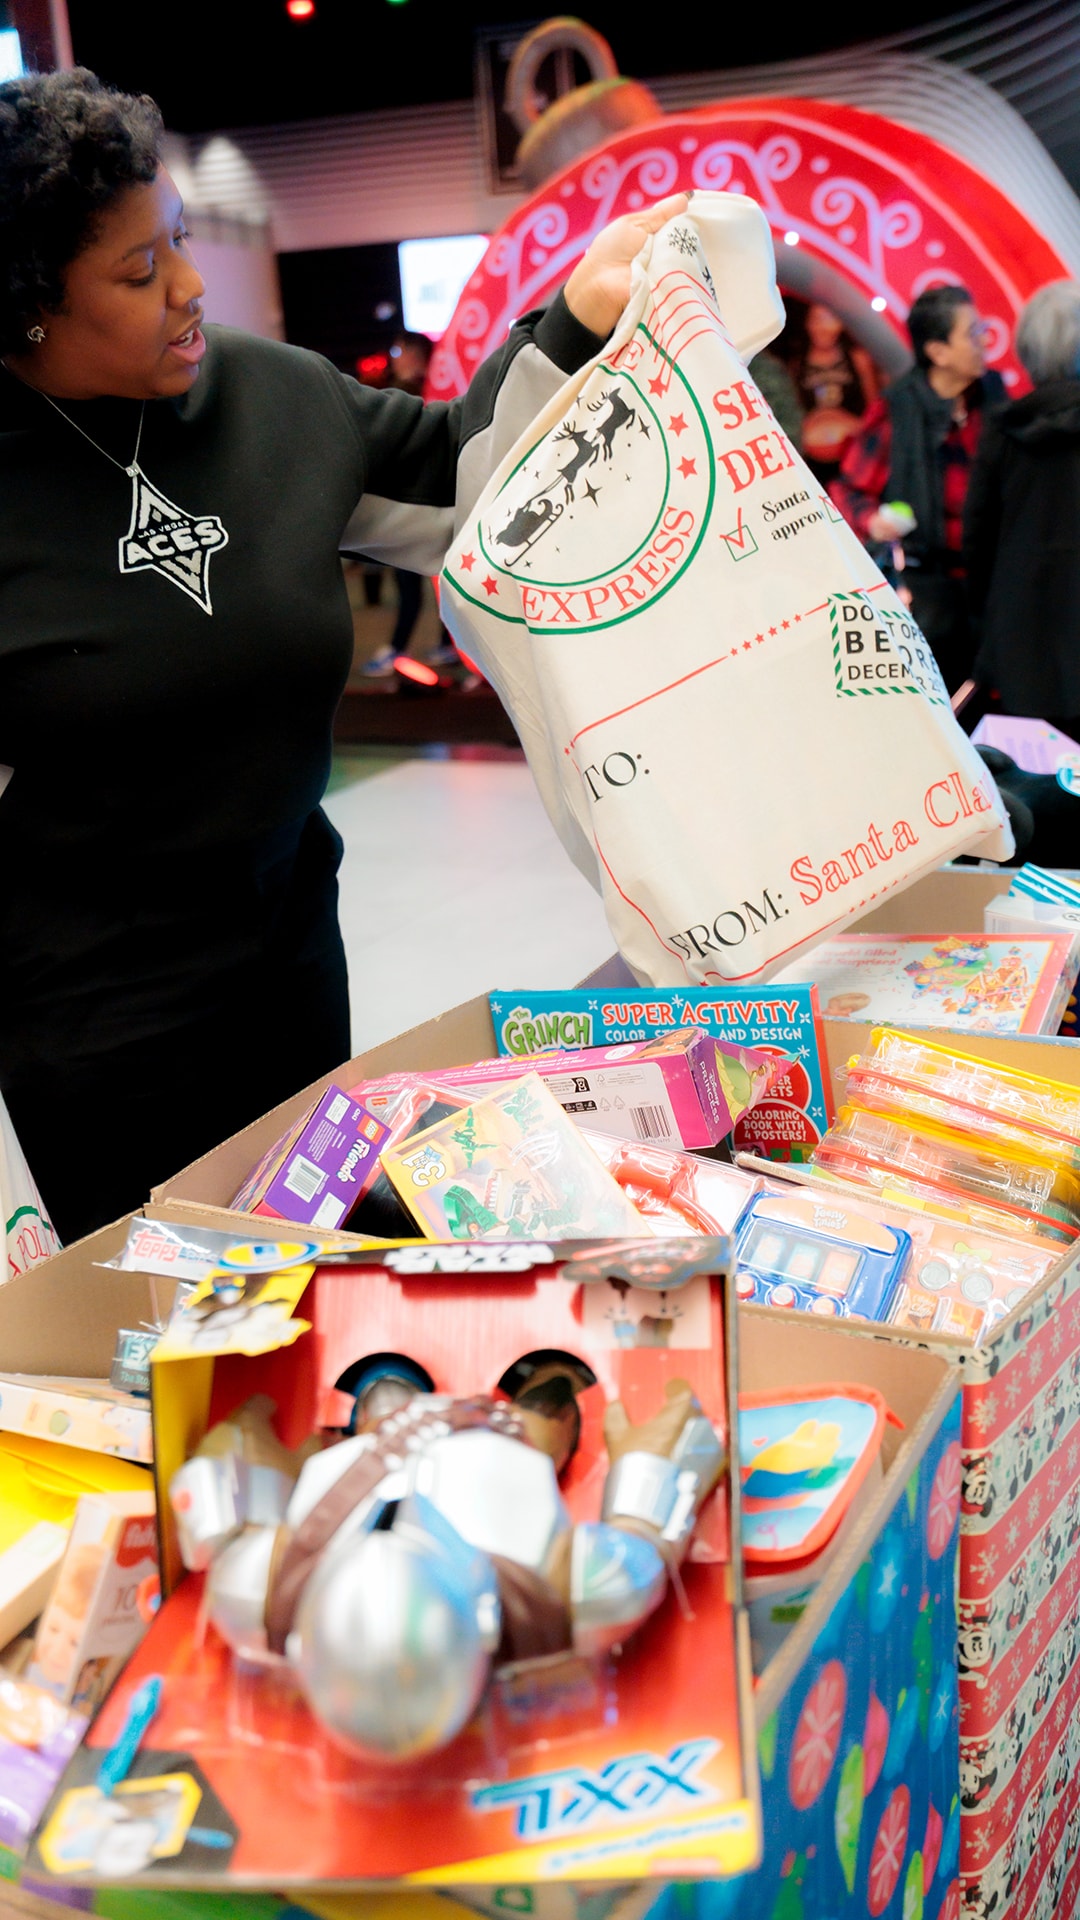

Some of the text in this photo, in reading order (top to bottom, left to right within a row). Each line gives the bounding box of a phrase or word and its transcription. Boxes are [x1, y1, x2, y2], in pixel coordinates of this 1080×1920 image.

[761, 490, 811, 523] Santa
[126, 521, 222, 565] ACES
[138, 520, 190, 538] LAS VEGAS
[519, 506, 695, 623] EXPRESS
[582, 751, 650, 803] TO:
[668, 888, 790, 961] FROM:
[789, 822, 920, 906] Santa
[512, 1009, 529, 1020] The
[602, 1000, 799, 1026] SUPER ACTIVITY
[504, 1014, 589, 1056] GRINCH
[719, 1028, 747, 1041] AND
[751, 1027, 803, 1041] DESIGN
[699, 1061, 720, 1124] PRINCESS
[743, 1120, 805, 1131] BOOK WITH
[745, 1110, 800, 1121] COLORING
[744, 1130, 807, 1141] 4 POSTERS!
[336, 1138, 371, 1183] Friends
